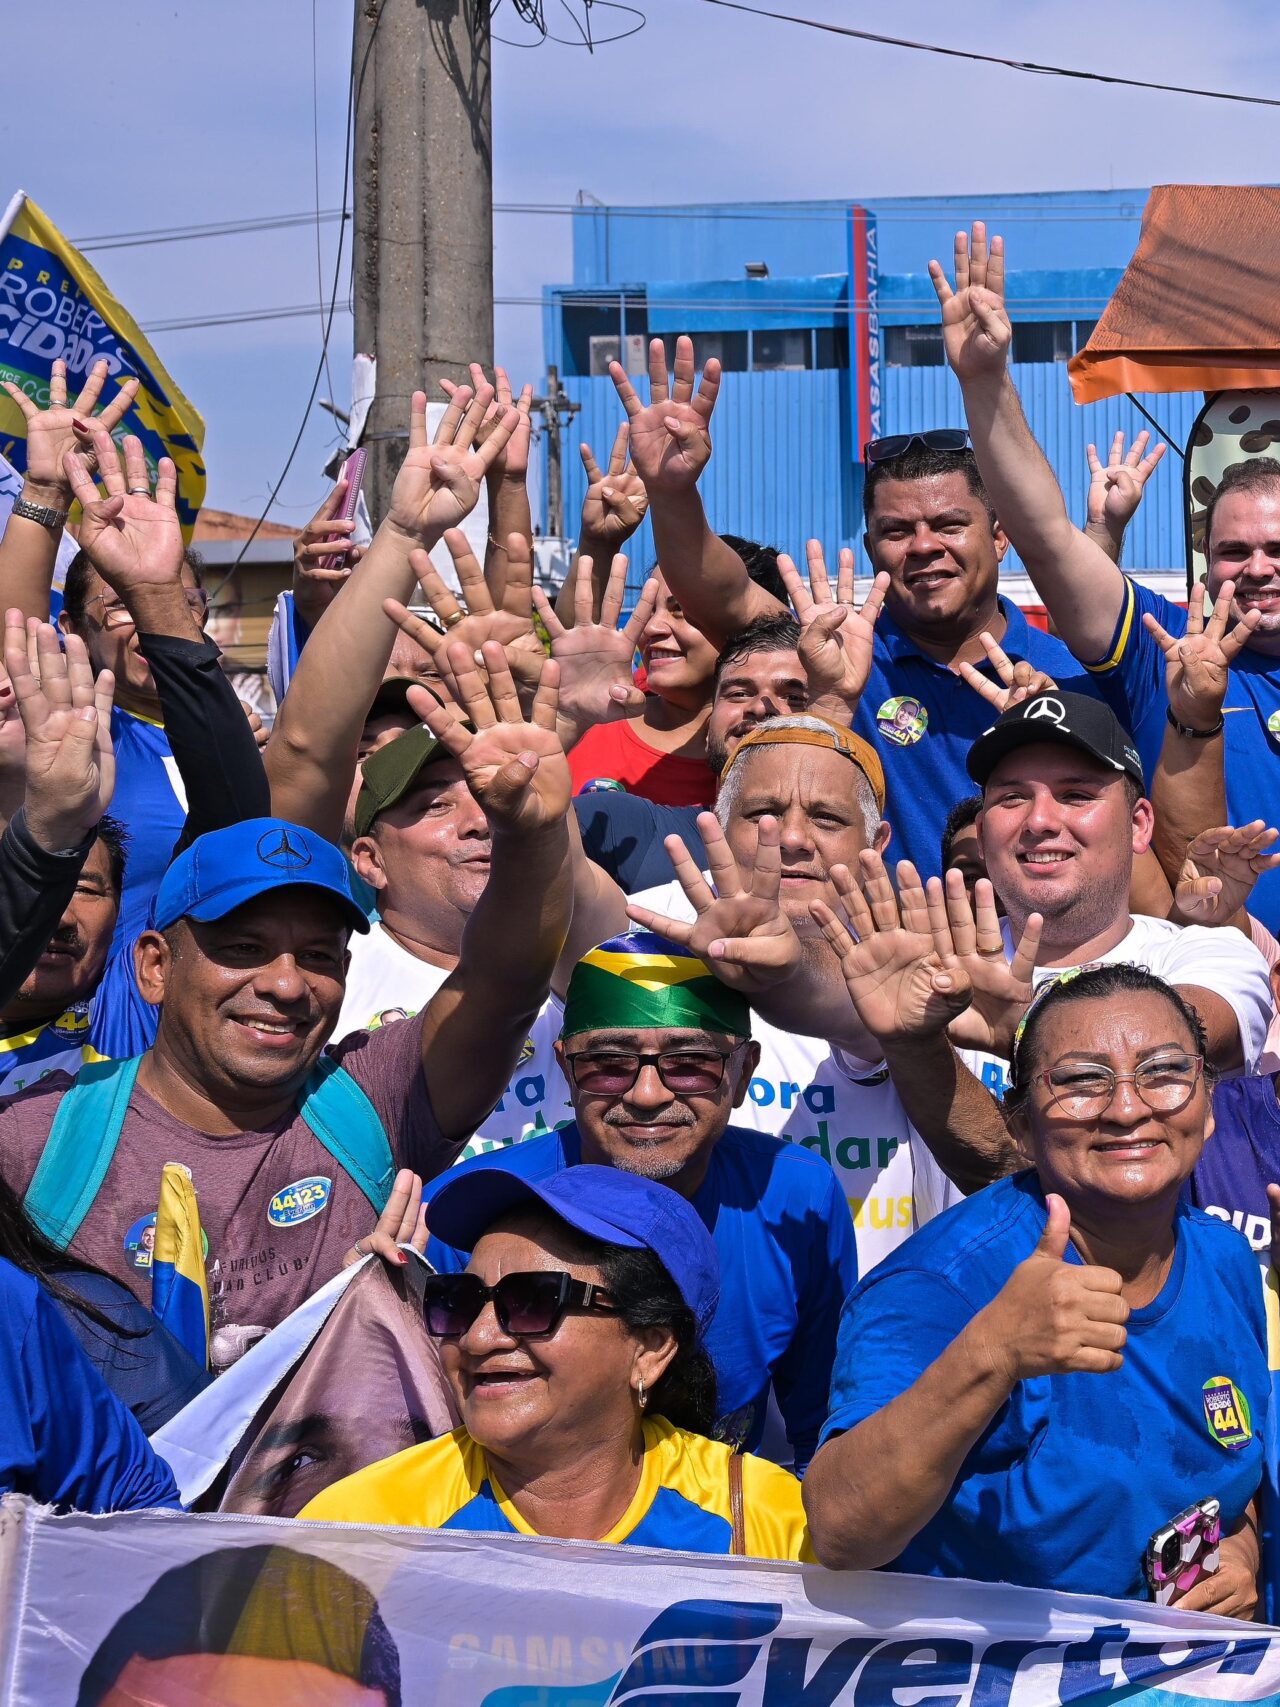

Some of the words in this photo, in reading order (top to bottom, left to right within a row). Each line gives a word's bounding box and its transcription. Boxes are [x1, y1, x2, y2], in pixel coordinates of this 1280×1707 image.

[7, 257, 85, 299] PREF
[866, 226, 882, 442] ASASBAHIA
[272, 1184, 326, 1211] 44123
[253, 1257, 303, 1286] CLUB
[1214, 1406, 1239, 1431] 44
